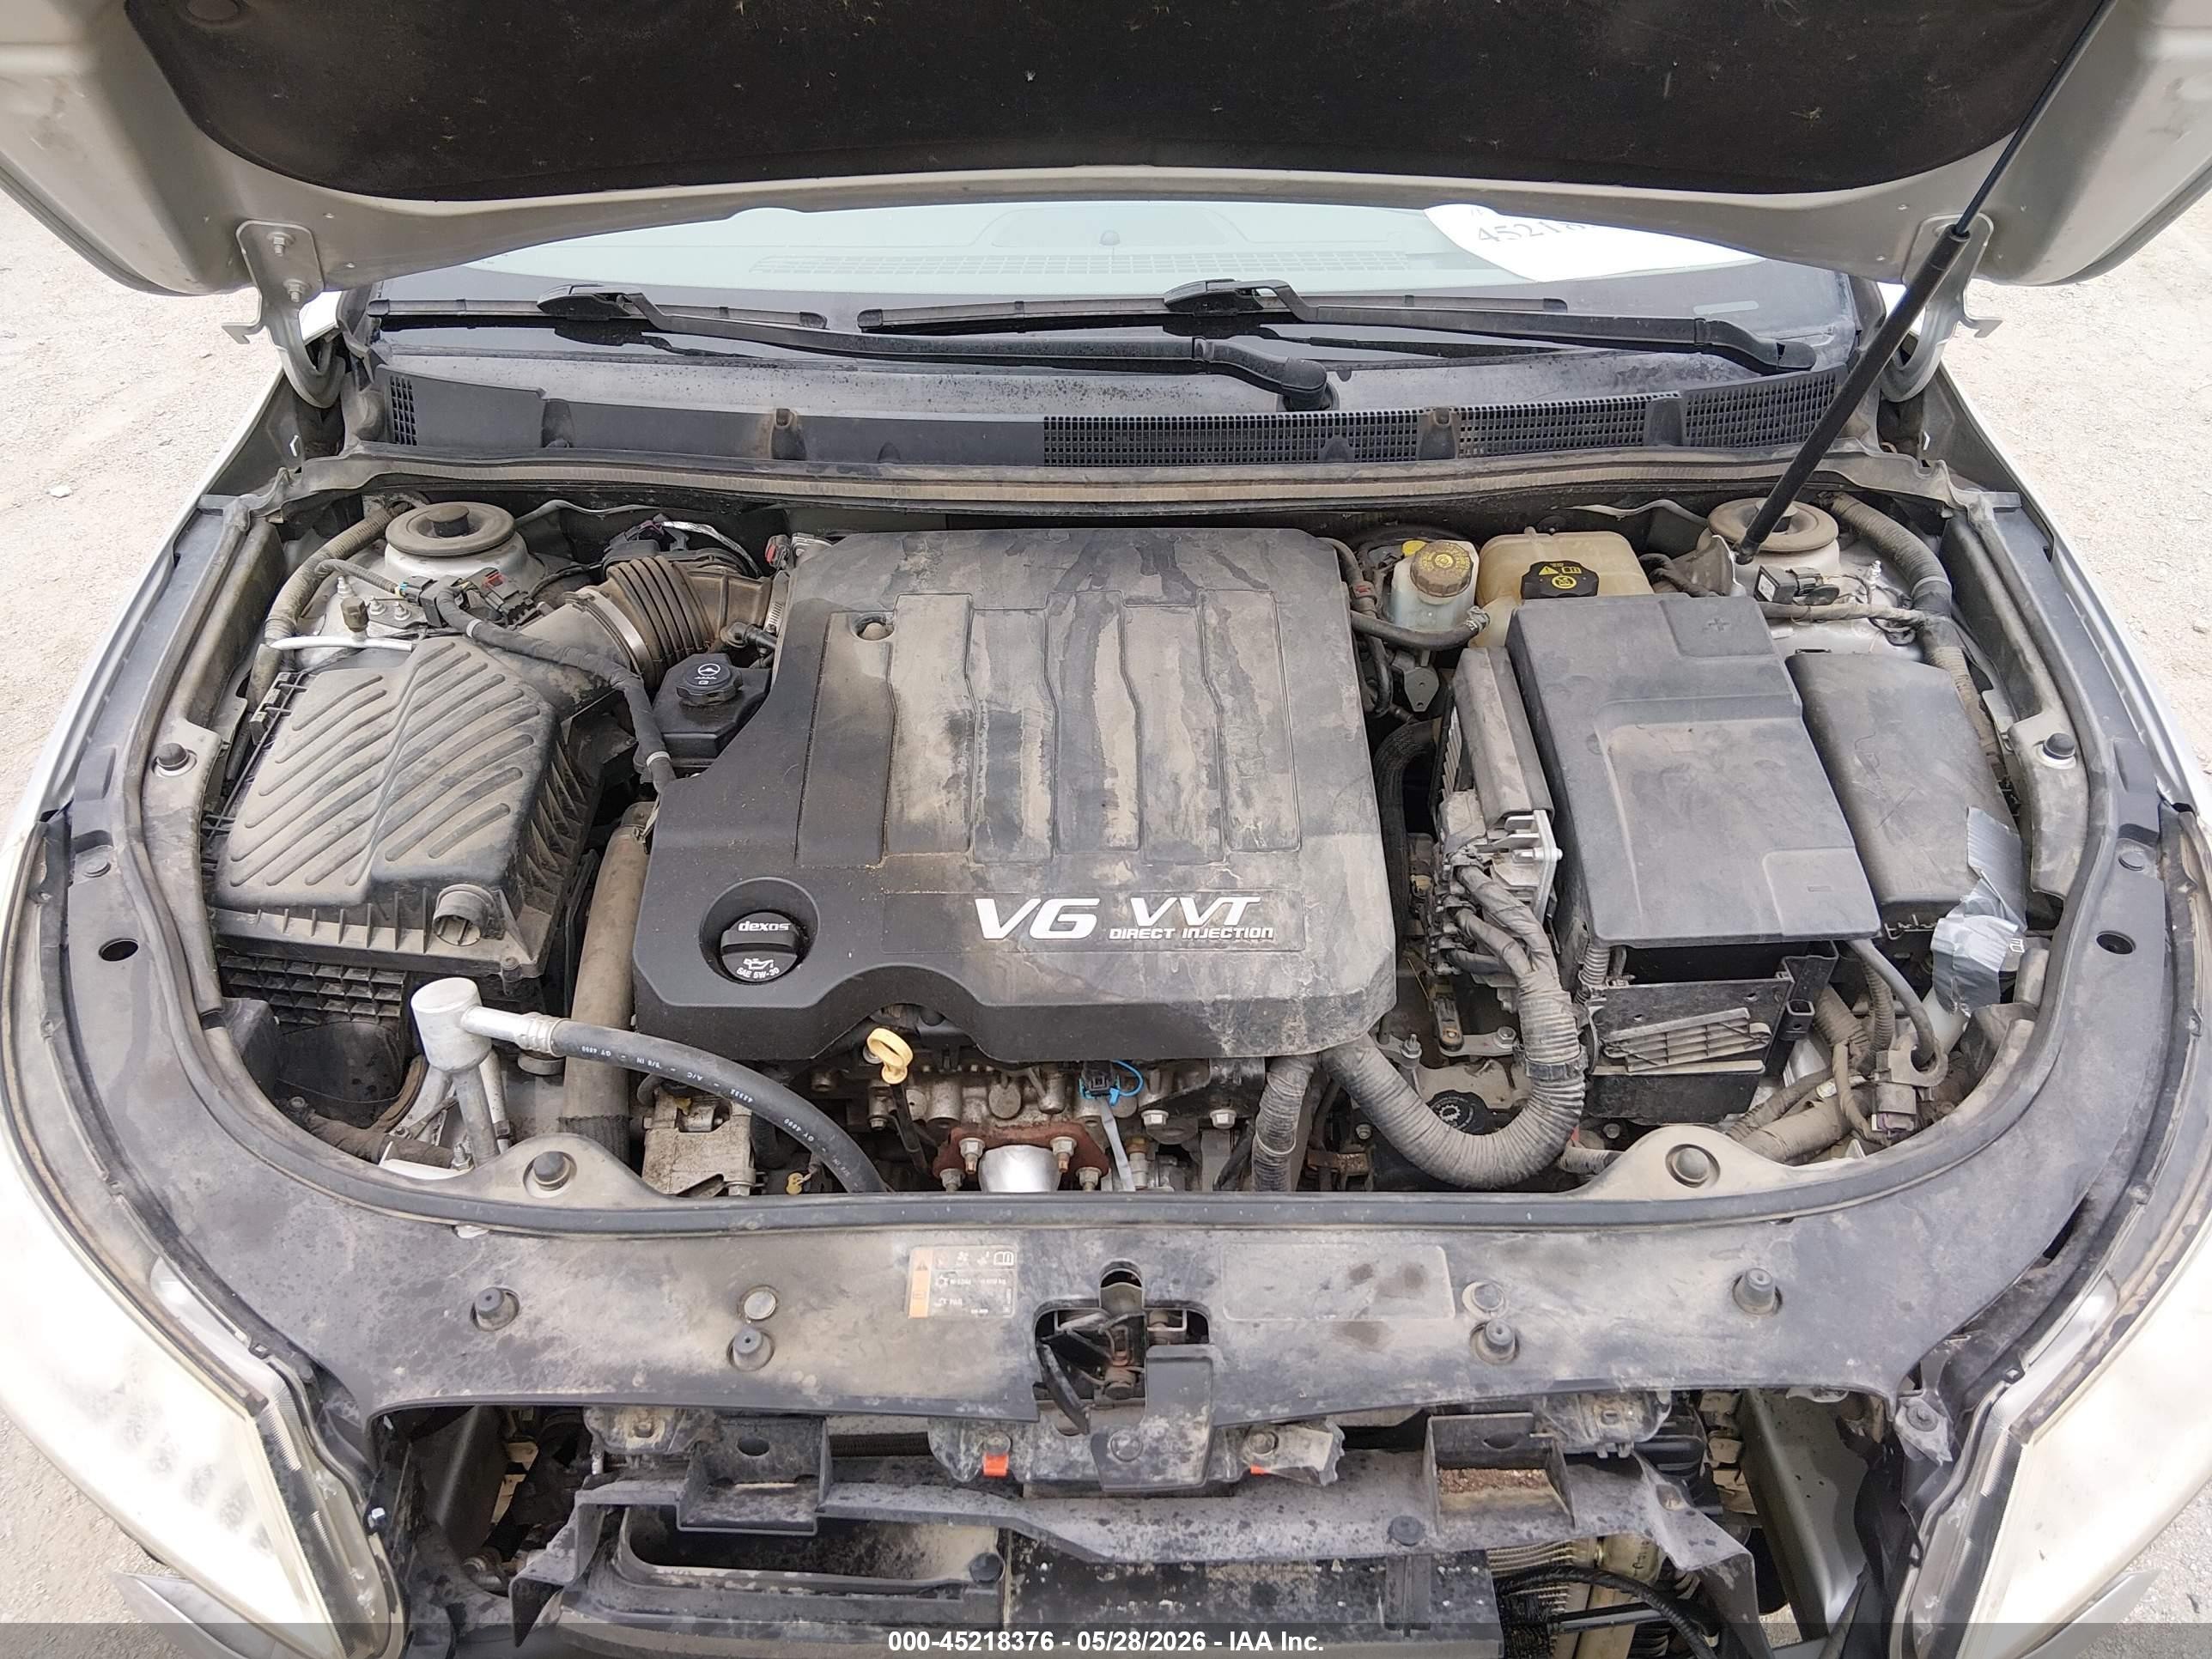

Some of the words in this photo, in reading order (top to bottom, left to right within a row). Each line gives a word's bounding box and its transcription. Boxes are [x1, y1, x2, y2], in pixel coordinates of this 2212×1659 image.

[975, 898, 1101, 939] V6
[1130, 896, 1261, 927] VVT
[738, 921, 791, 932] dexos
[1109, 927, 1176, 939] DIRECT
[1182, 926, 1274, 939] INJECTION
[737, 967, 752, 978] SAE
[753, 967, 780, 979] 5W-30
[687, 1072, 703, 1081] A/C
